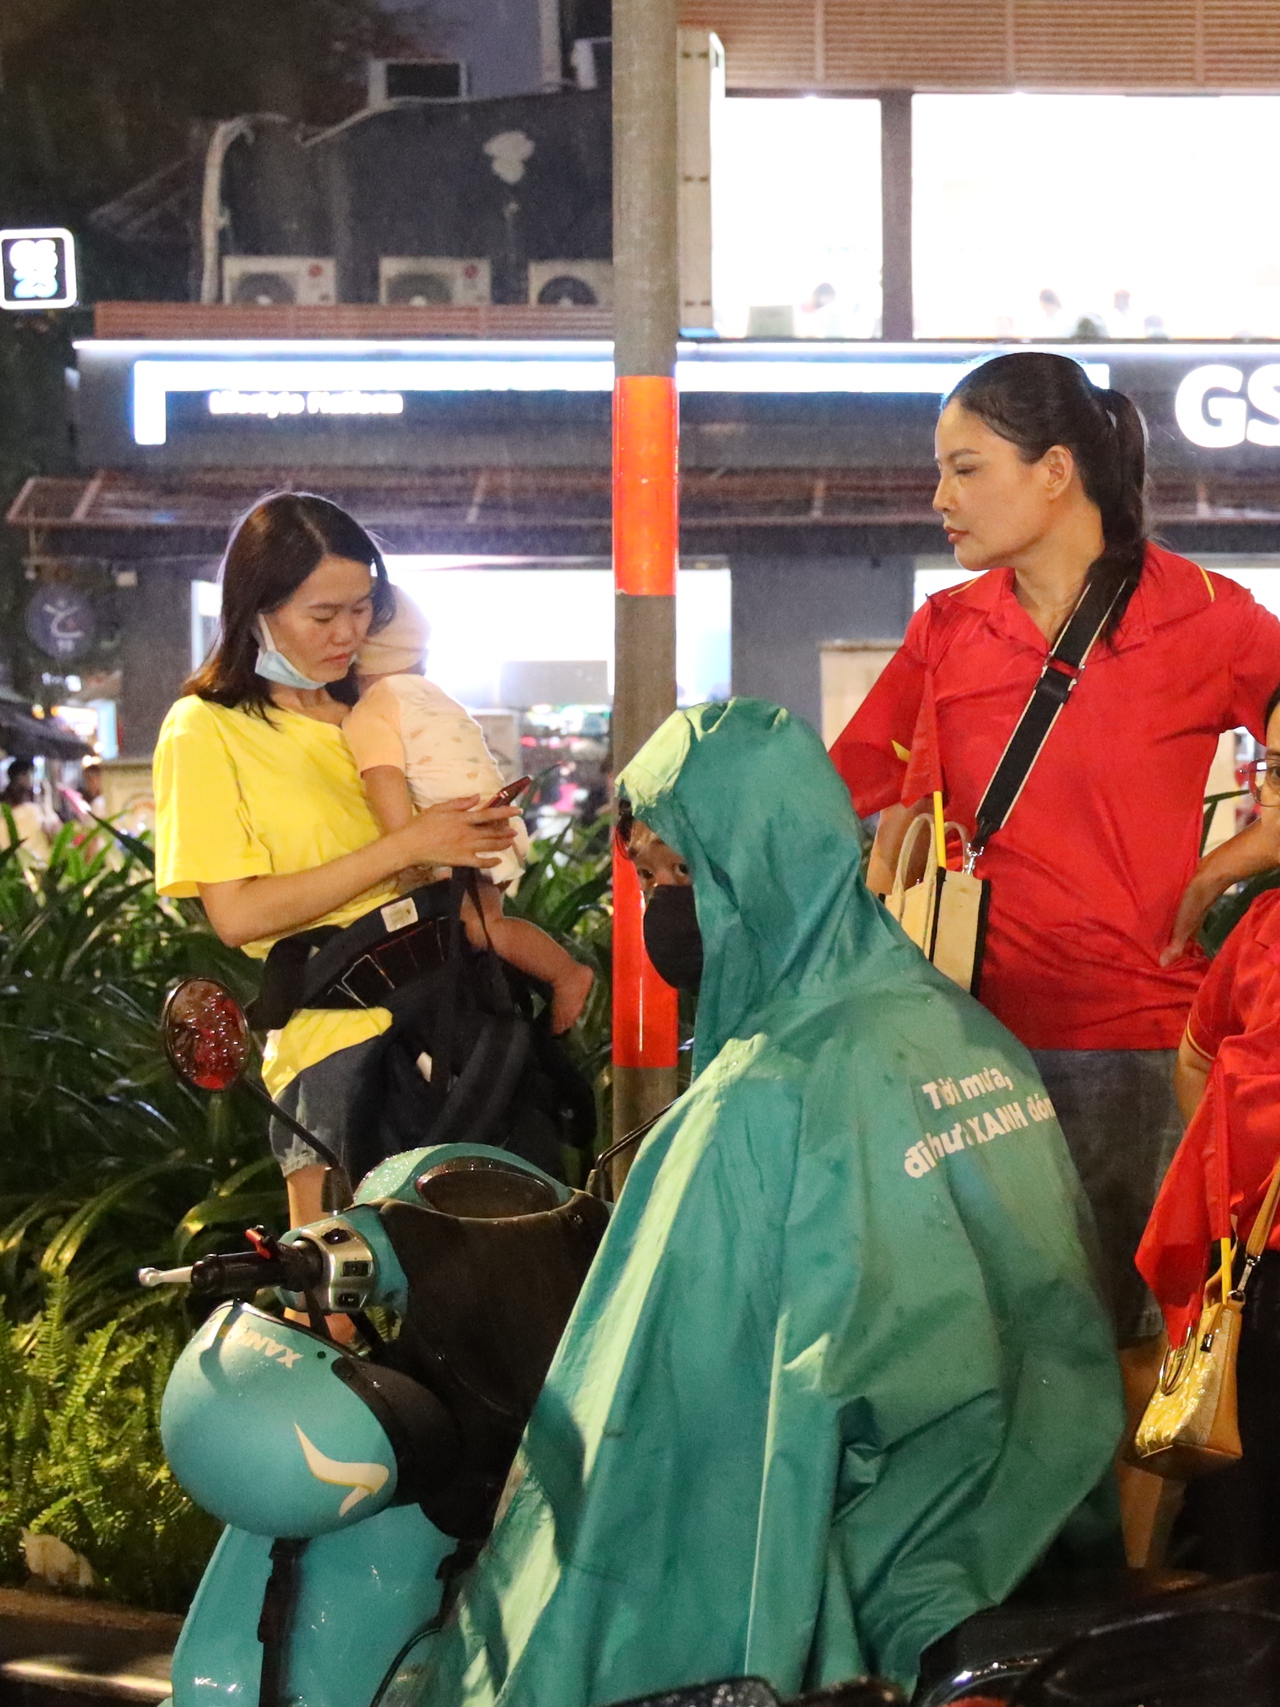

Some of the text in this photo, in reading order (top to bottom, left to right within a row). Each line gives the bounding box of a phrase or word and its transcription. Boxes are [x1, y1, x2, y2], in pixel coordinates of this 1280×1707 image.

[921, 1067, 1013, 1110] Tời mưa,
[966, 1102, 1028, 1143] XANH
